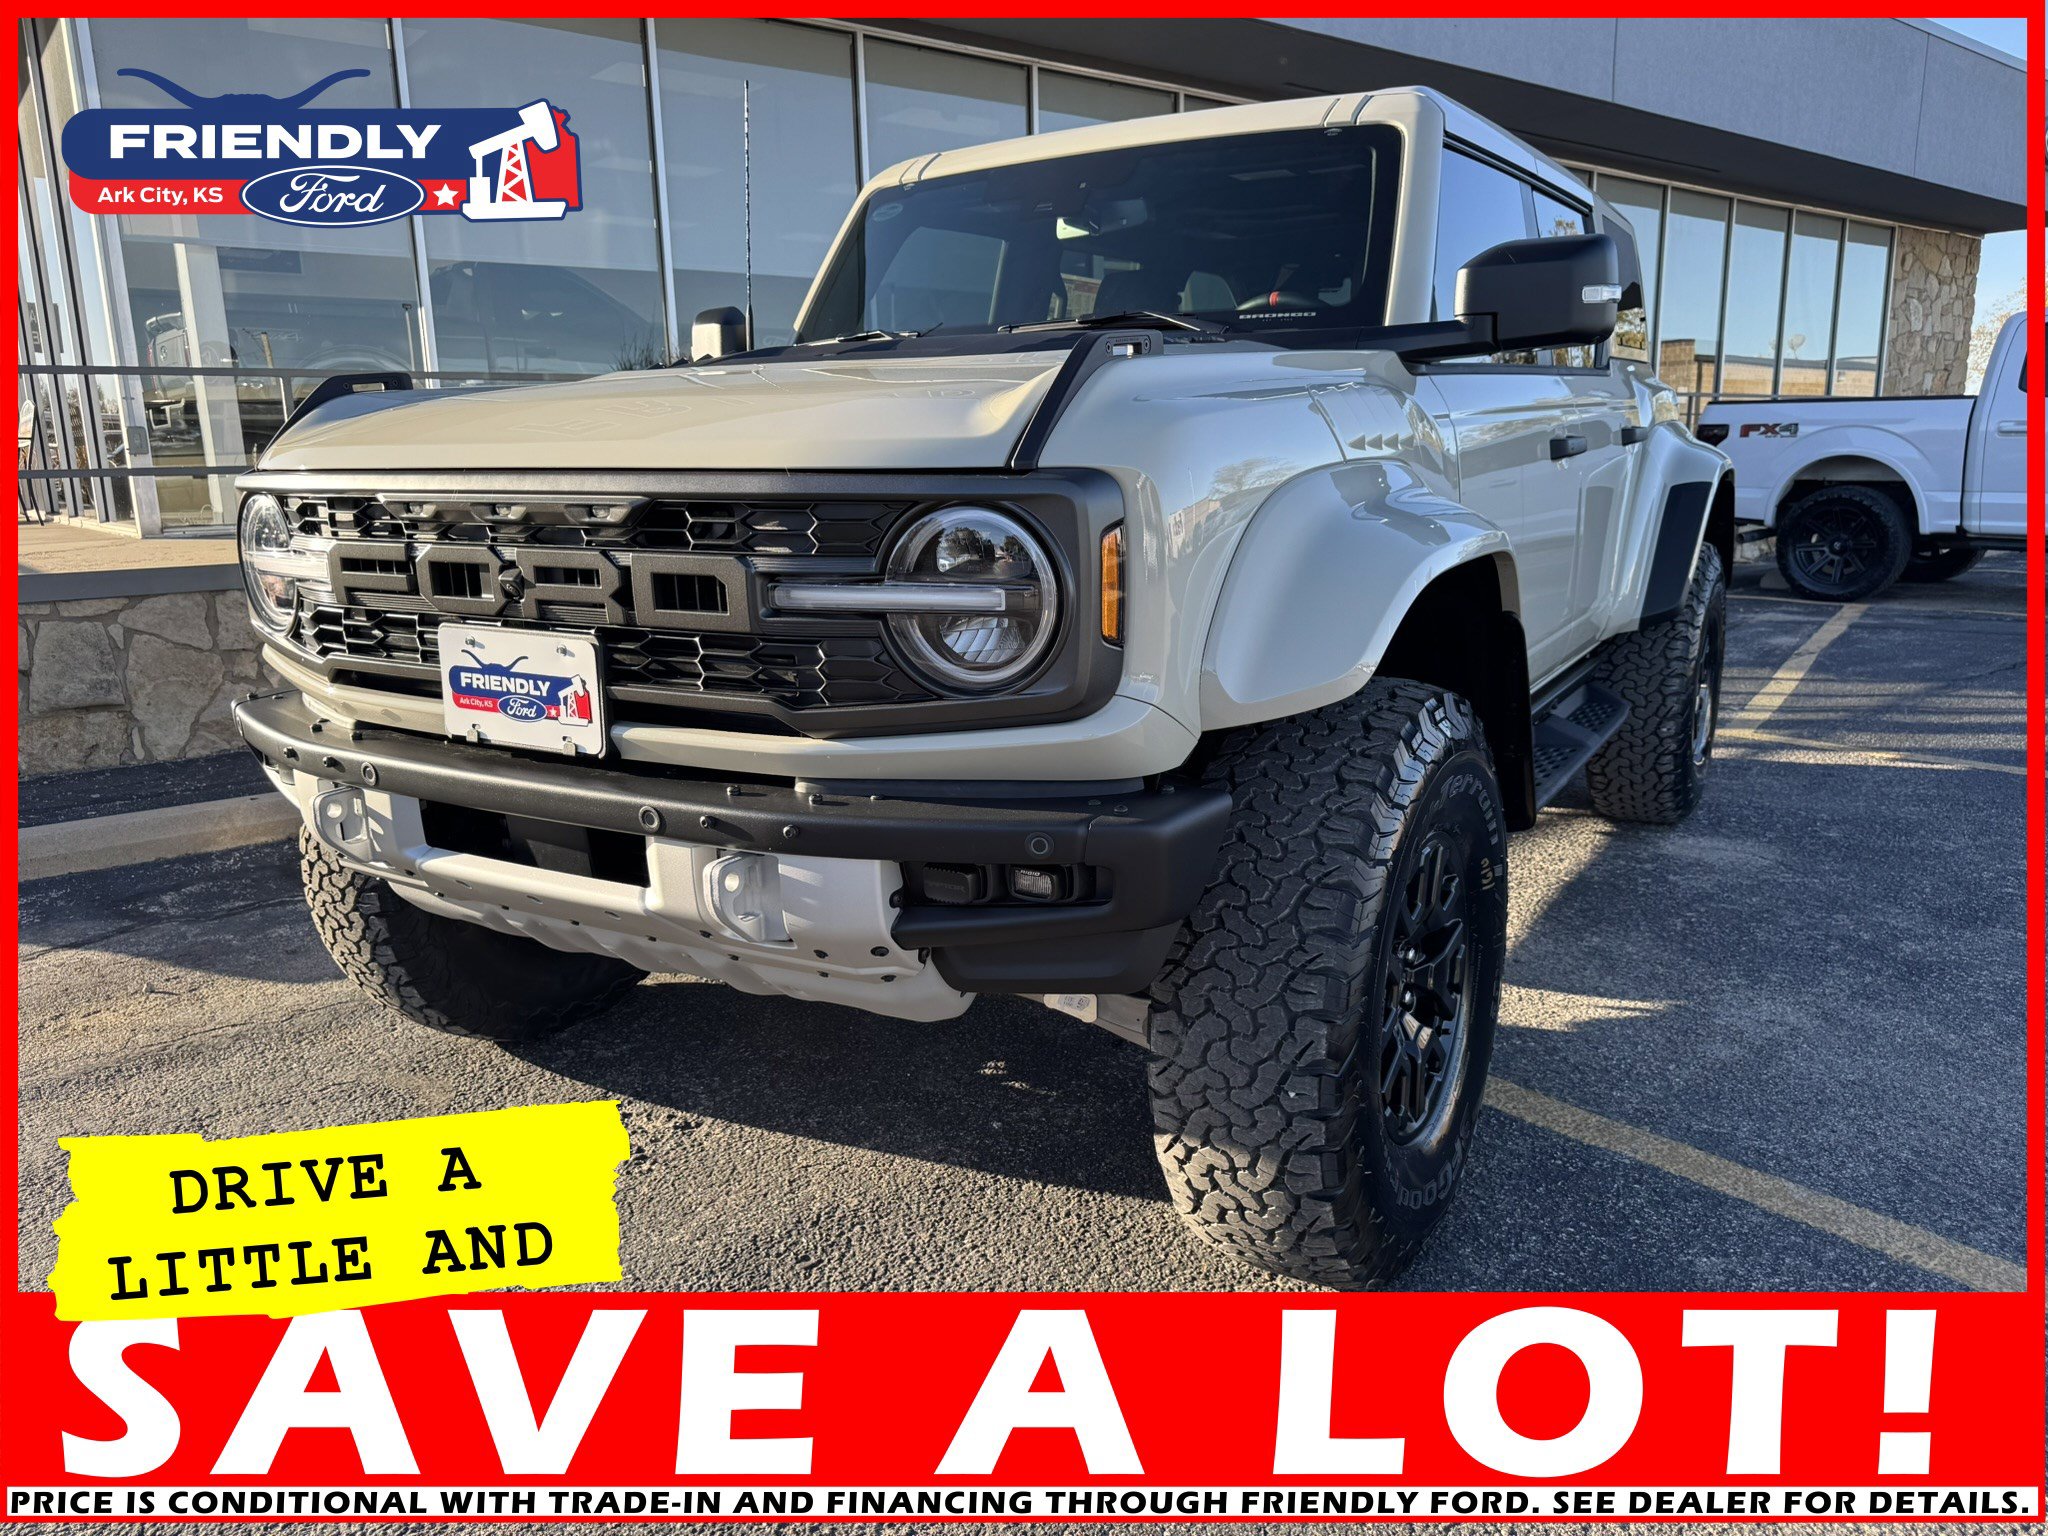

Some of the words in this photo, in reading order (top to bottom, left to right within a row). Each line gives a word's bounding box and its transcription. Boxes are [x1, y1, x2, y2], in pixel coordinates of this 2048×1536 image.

[1740, 423, 1798, 438] FX4
[329, 542, 752, 633] FORD
[460, 672, 550, 696] FRIENDLY
[460, 696, 470, 705] Ark
[484, 700, 494, 708] KS
[507, 698, 537, 718] Ford
